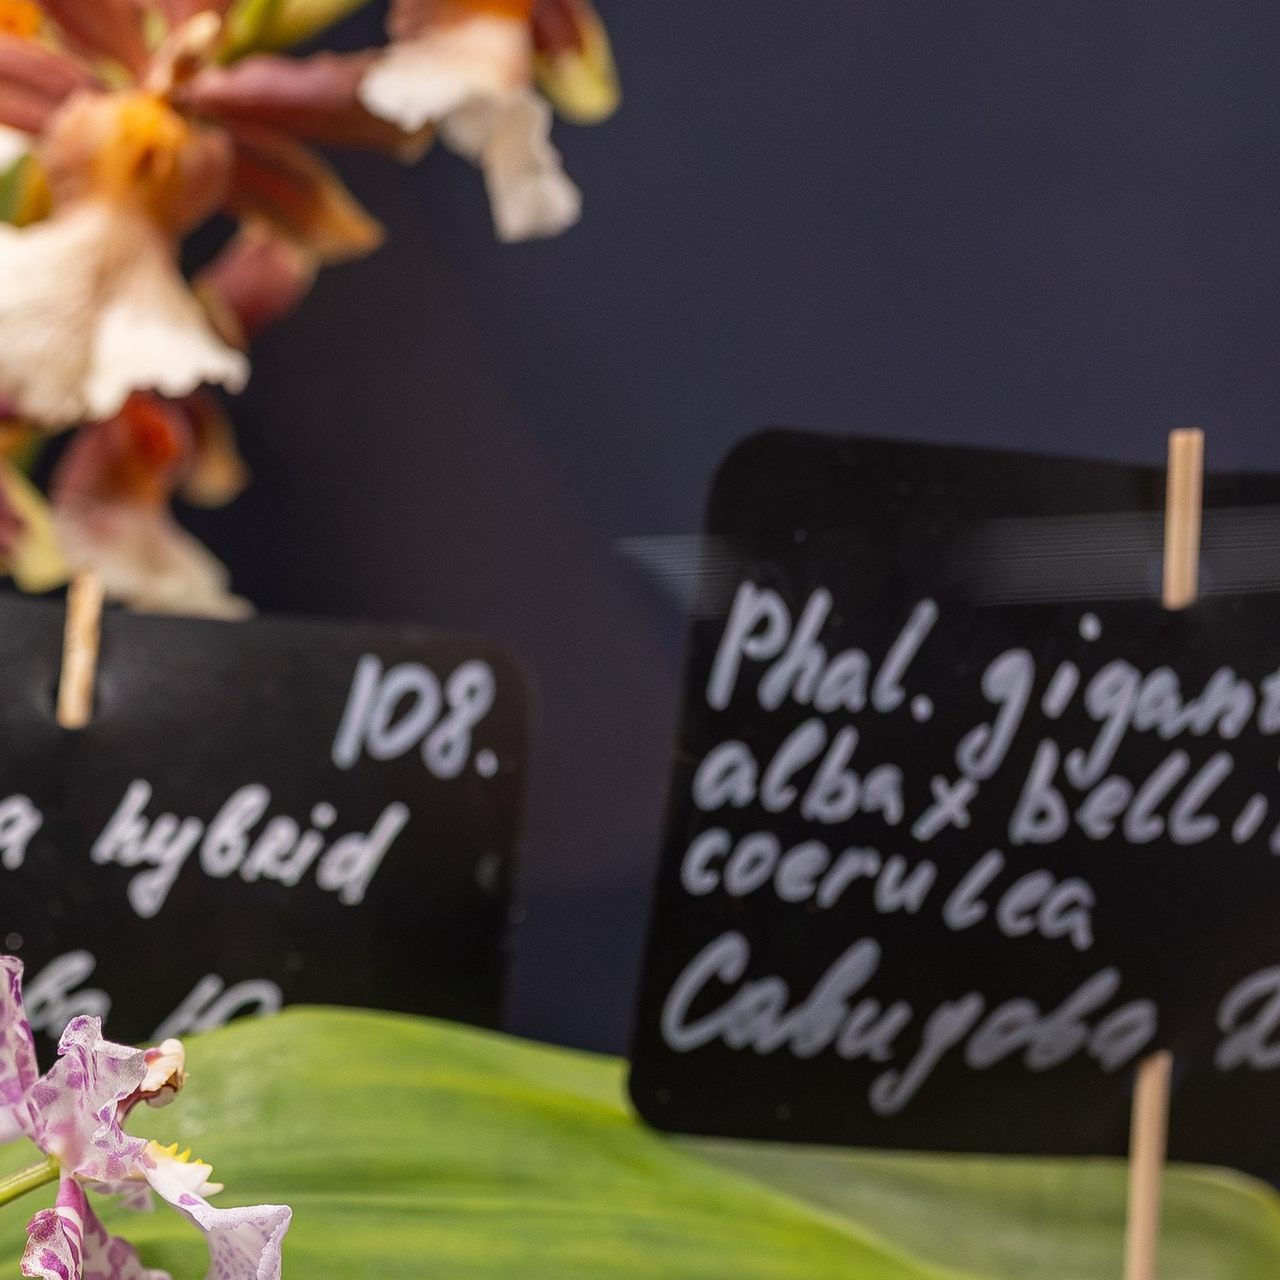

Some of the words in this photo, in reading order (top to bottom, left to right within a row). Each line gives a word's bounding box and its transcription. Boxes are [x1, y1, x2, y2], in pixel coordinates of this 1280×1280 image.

[331, 654, 499, 778] 108.
[706, 580, 938, 721] Phal.
[692, 718, 905, 826] alba
[1008, 737, 1280, 856] belli
[680, 827, 1095, 952] coerulea
